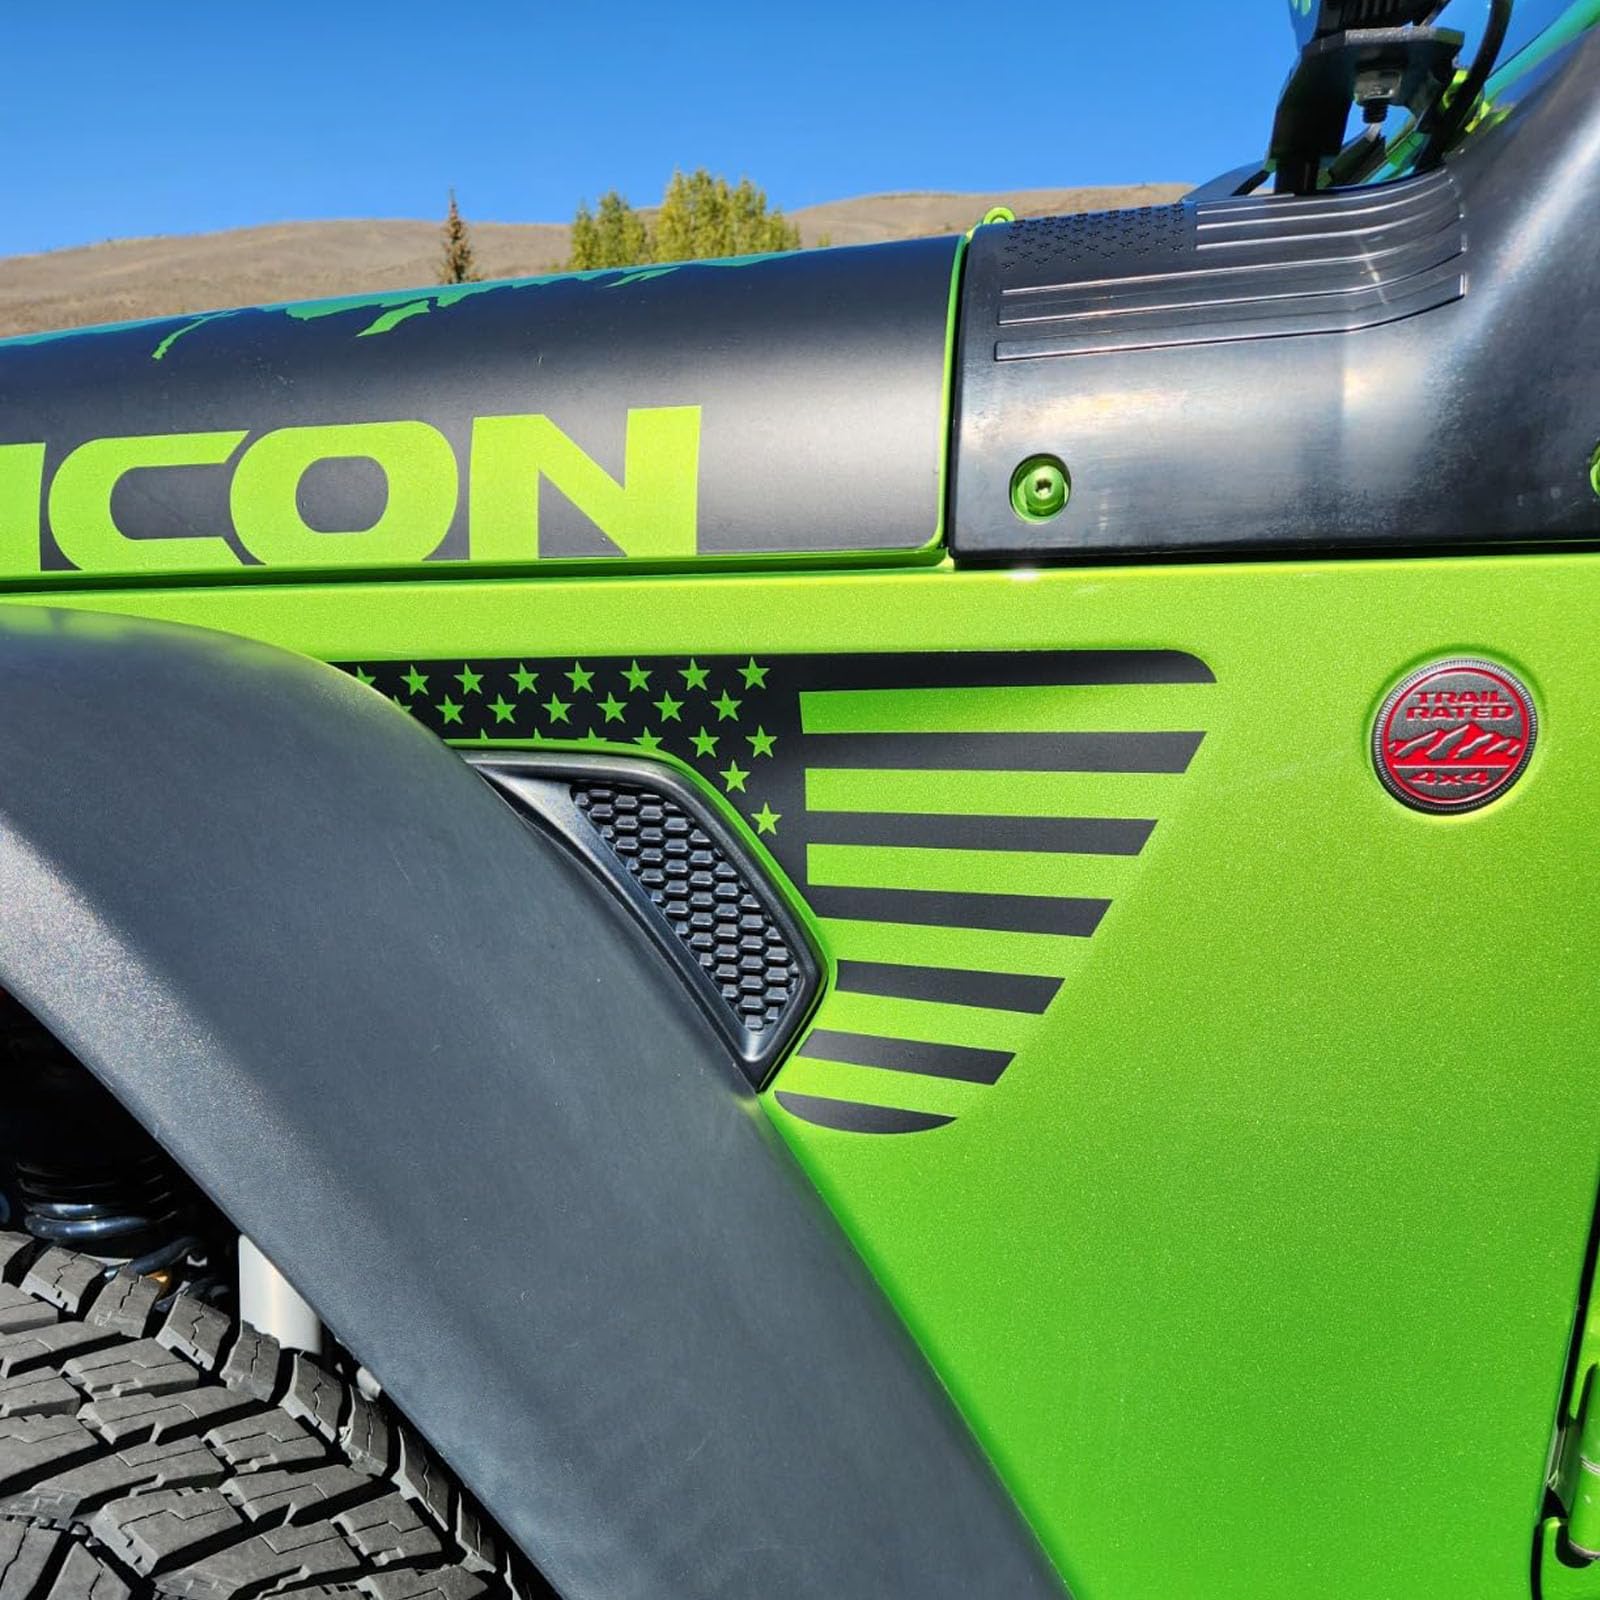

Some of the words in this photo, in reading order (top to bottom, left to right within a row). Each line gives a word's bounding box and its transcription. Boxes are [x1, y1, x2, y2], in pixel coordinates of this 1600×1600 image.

[1415, 691, 1508, 706] TRAIL
[1406, 705, 1514, 721] RATED
[1409, 770, 1490, 785] 4x4
